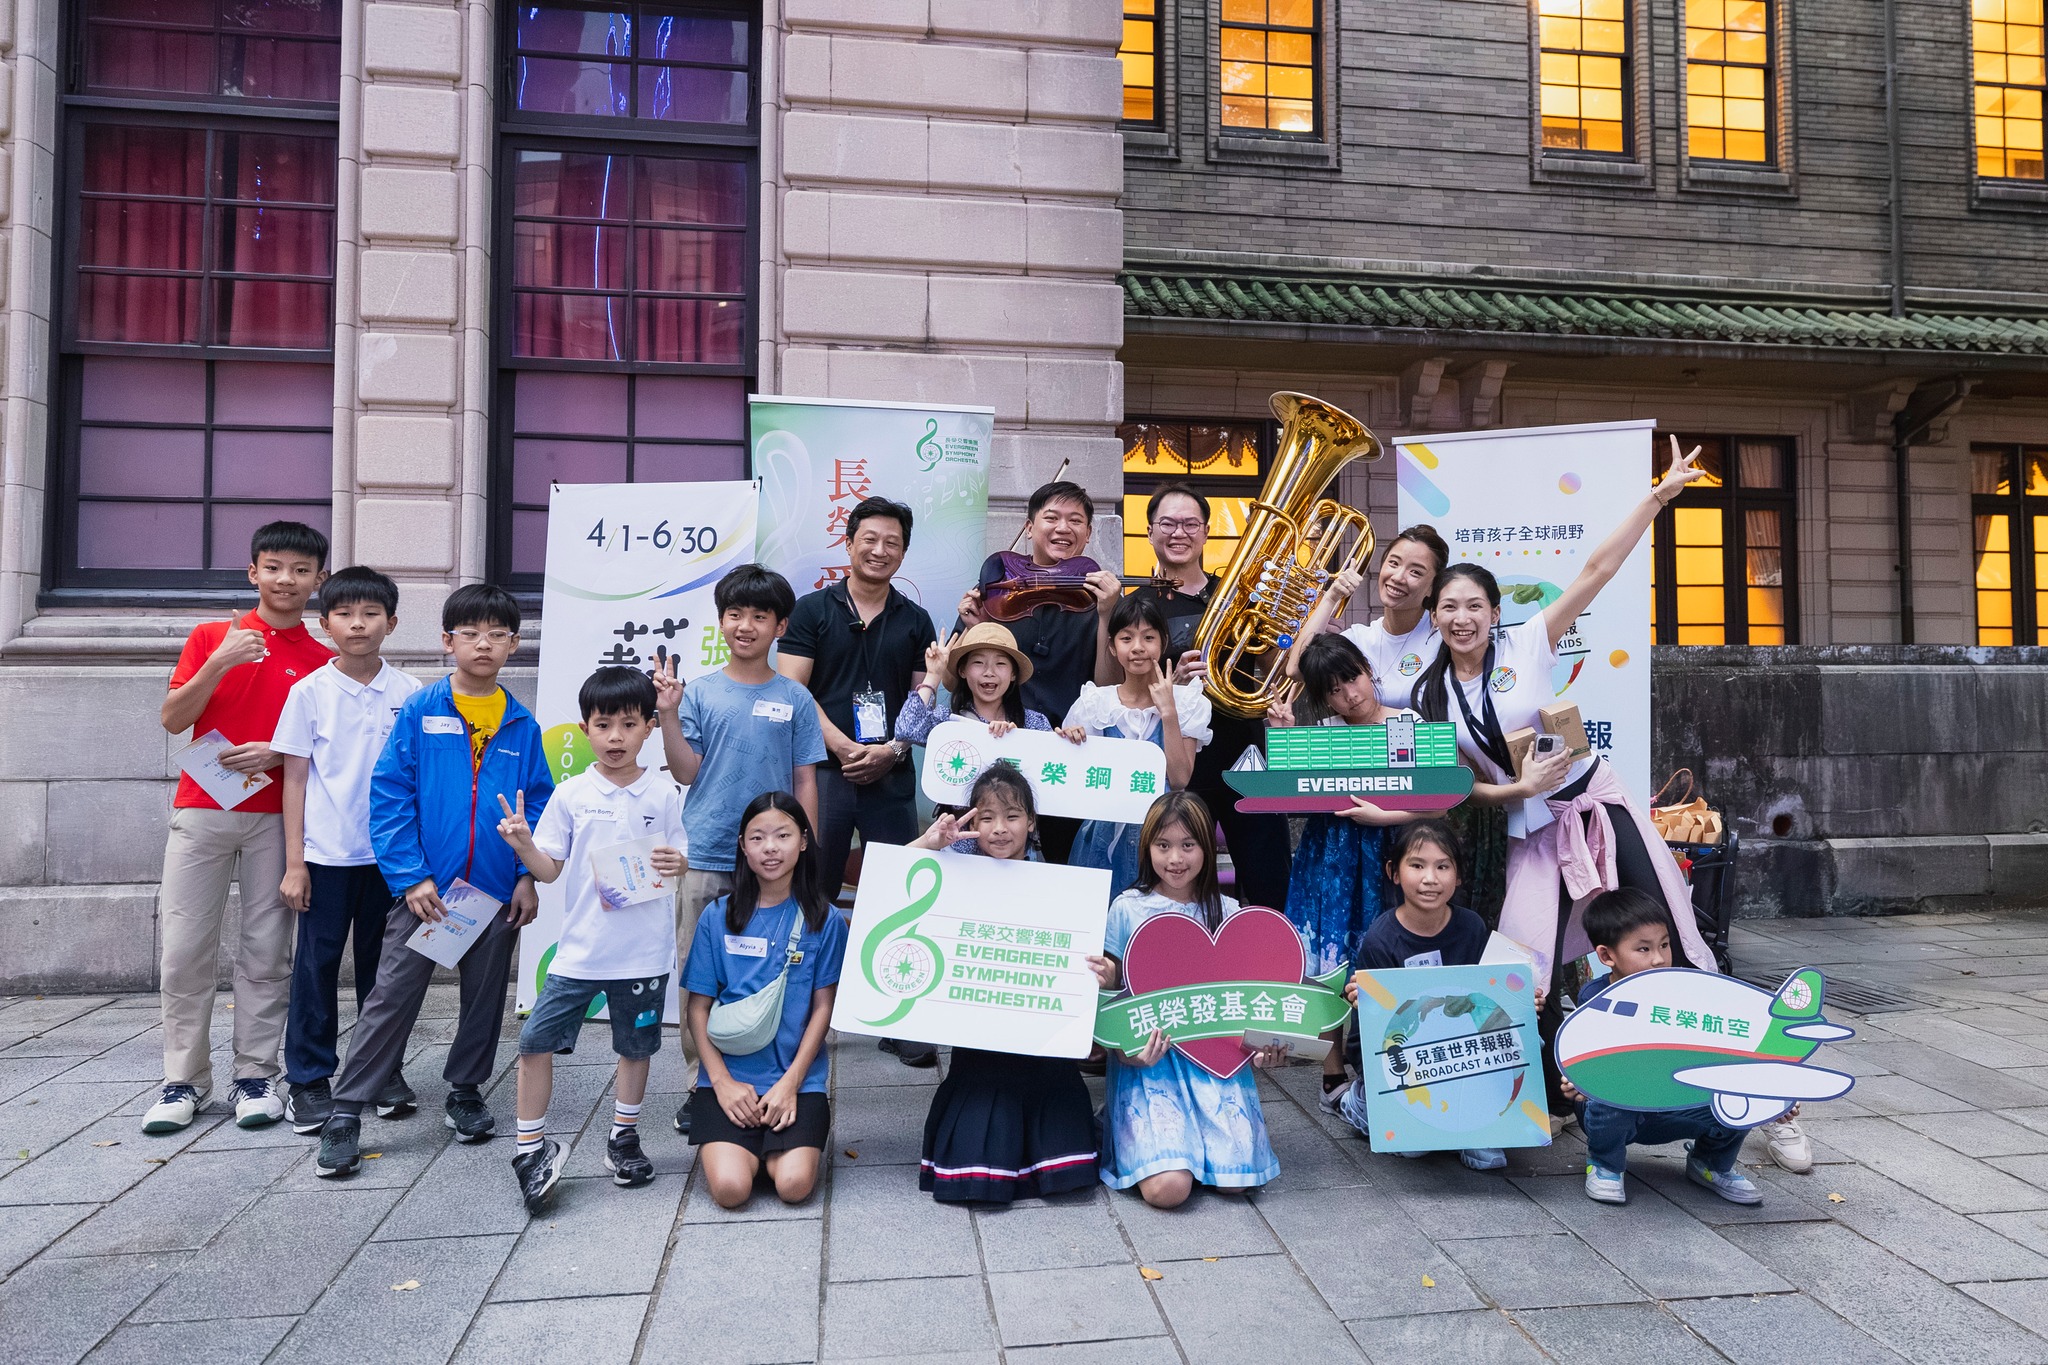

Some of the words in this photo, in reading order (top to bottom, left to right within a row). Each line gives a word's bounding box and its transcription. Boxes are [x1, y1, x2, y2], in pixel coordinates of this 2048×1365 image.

[1455, 524, 1584, 543] 培育孩子全球視野
[1556, 637, 1583, 650] KIDS
[937, 763, 978, 784] EVERGREEN
[1297, 776, 1413, 792] EVERGREEN
[958, 921, 1072, 949] 長榮交響樂團
[955, 943, 1069, 969] EVERGREEN
[883, 968, 925, 990] EVERGREEN
[952, 964, 1057, 988] SYMPHONY
[948, 986, 1063, 1012] ORCHESTRA
[1127, 990, 1308, 1039] 張榮發基金會
[1650, 1005, 1750, 1038] 長榮航空
[1415, 1031, 1515, 1067] 兒童世界報報
[1414, 1058, 1481, 1081] BROADCAST
[1484, 1056, 1491, 1067] 4
[1493, 1050, 1521, 1065] KIDS
